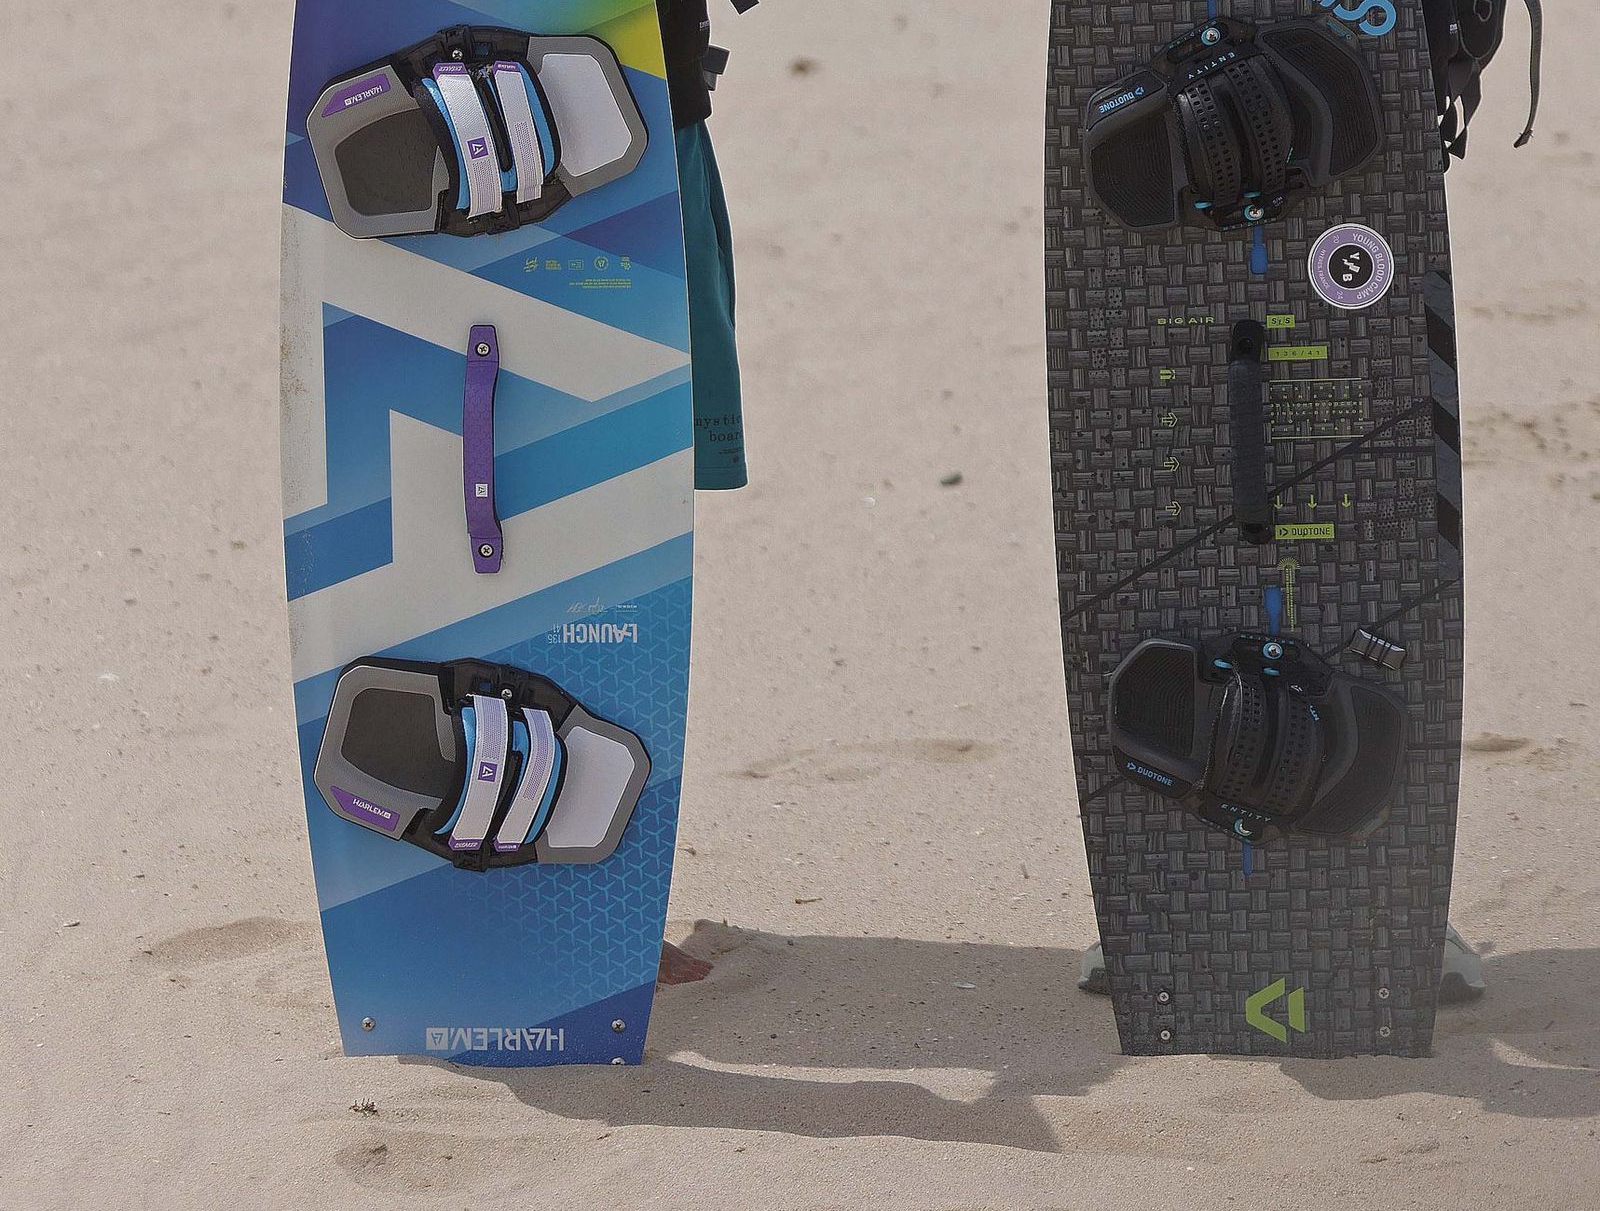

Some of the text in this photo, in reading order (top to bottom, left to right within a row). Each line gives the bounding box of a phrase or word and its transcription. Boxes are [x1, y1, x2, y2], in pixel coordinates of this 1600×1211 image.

[1187, 51, 1236, 80] ENTITY
[1099, 91, 1135, 114] DUOTONE
[1352, 233, 1385, 300] YOUNG BLOOD CAMP
[1157, 316, 1215, 325] BIG AIR
[1292, 527, 1331, 536] DUOTONE
[563, 623, 638, 644] LAUNCH
[1137, 766, 1174, 787] DUOTONE
[352, 797, 384, 818] HARLEM
[1220, 803, 1272, 823] ENTITY
[452, 1027, 565, 1052] HARLEM
